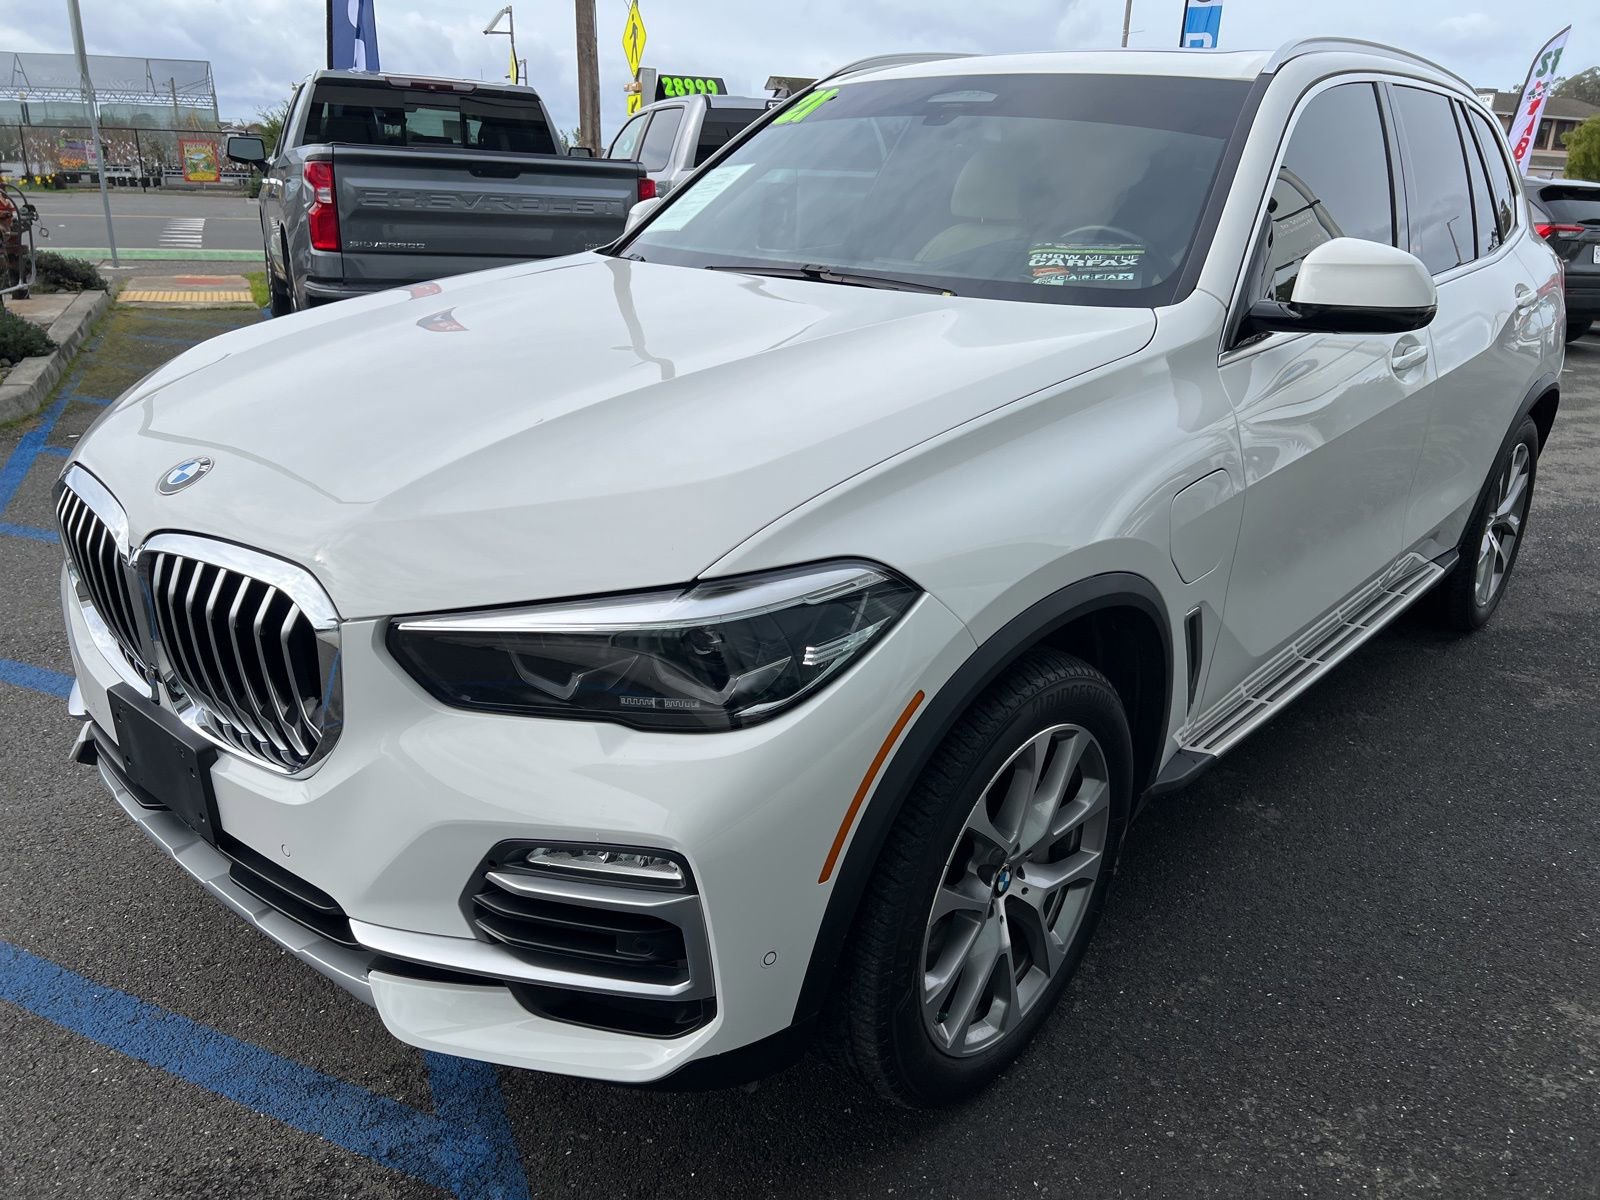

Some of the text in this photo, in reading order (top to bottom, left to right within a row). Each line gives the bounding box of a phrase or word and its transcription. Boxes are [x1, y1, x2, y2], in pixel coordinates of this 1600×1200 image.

[661, 77, 719, 97] 28999
[360, 191, 627, 215] CHEVROLET
[349, 240, 425, 249] SILVERADO
[1029, 259, 1138, 267] CARFAX
[1058, 273, 1134, 281] CARFAX
